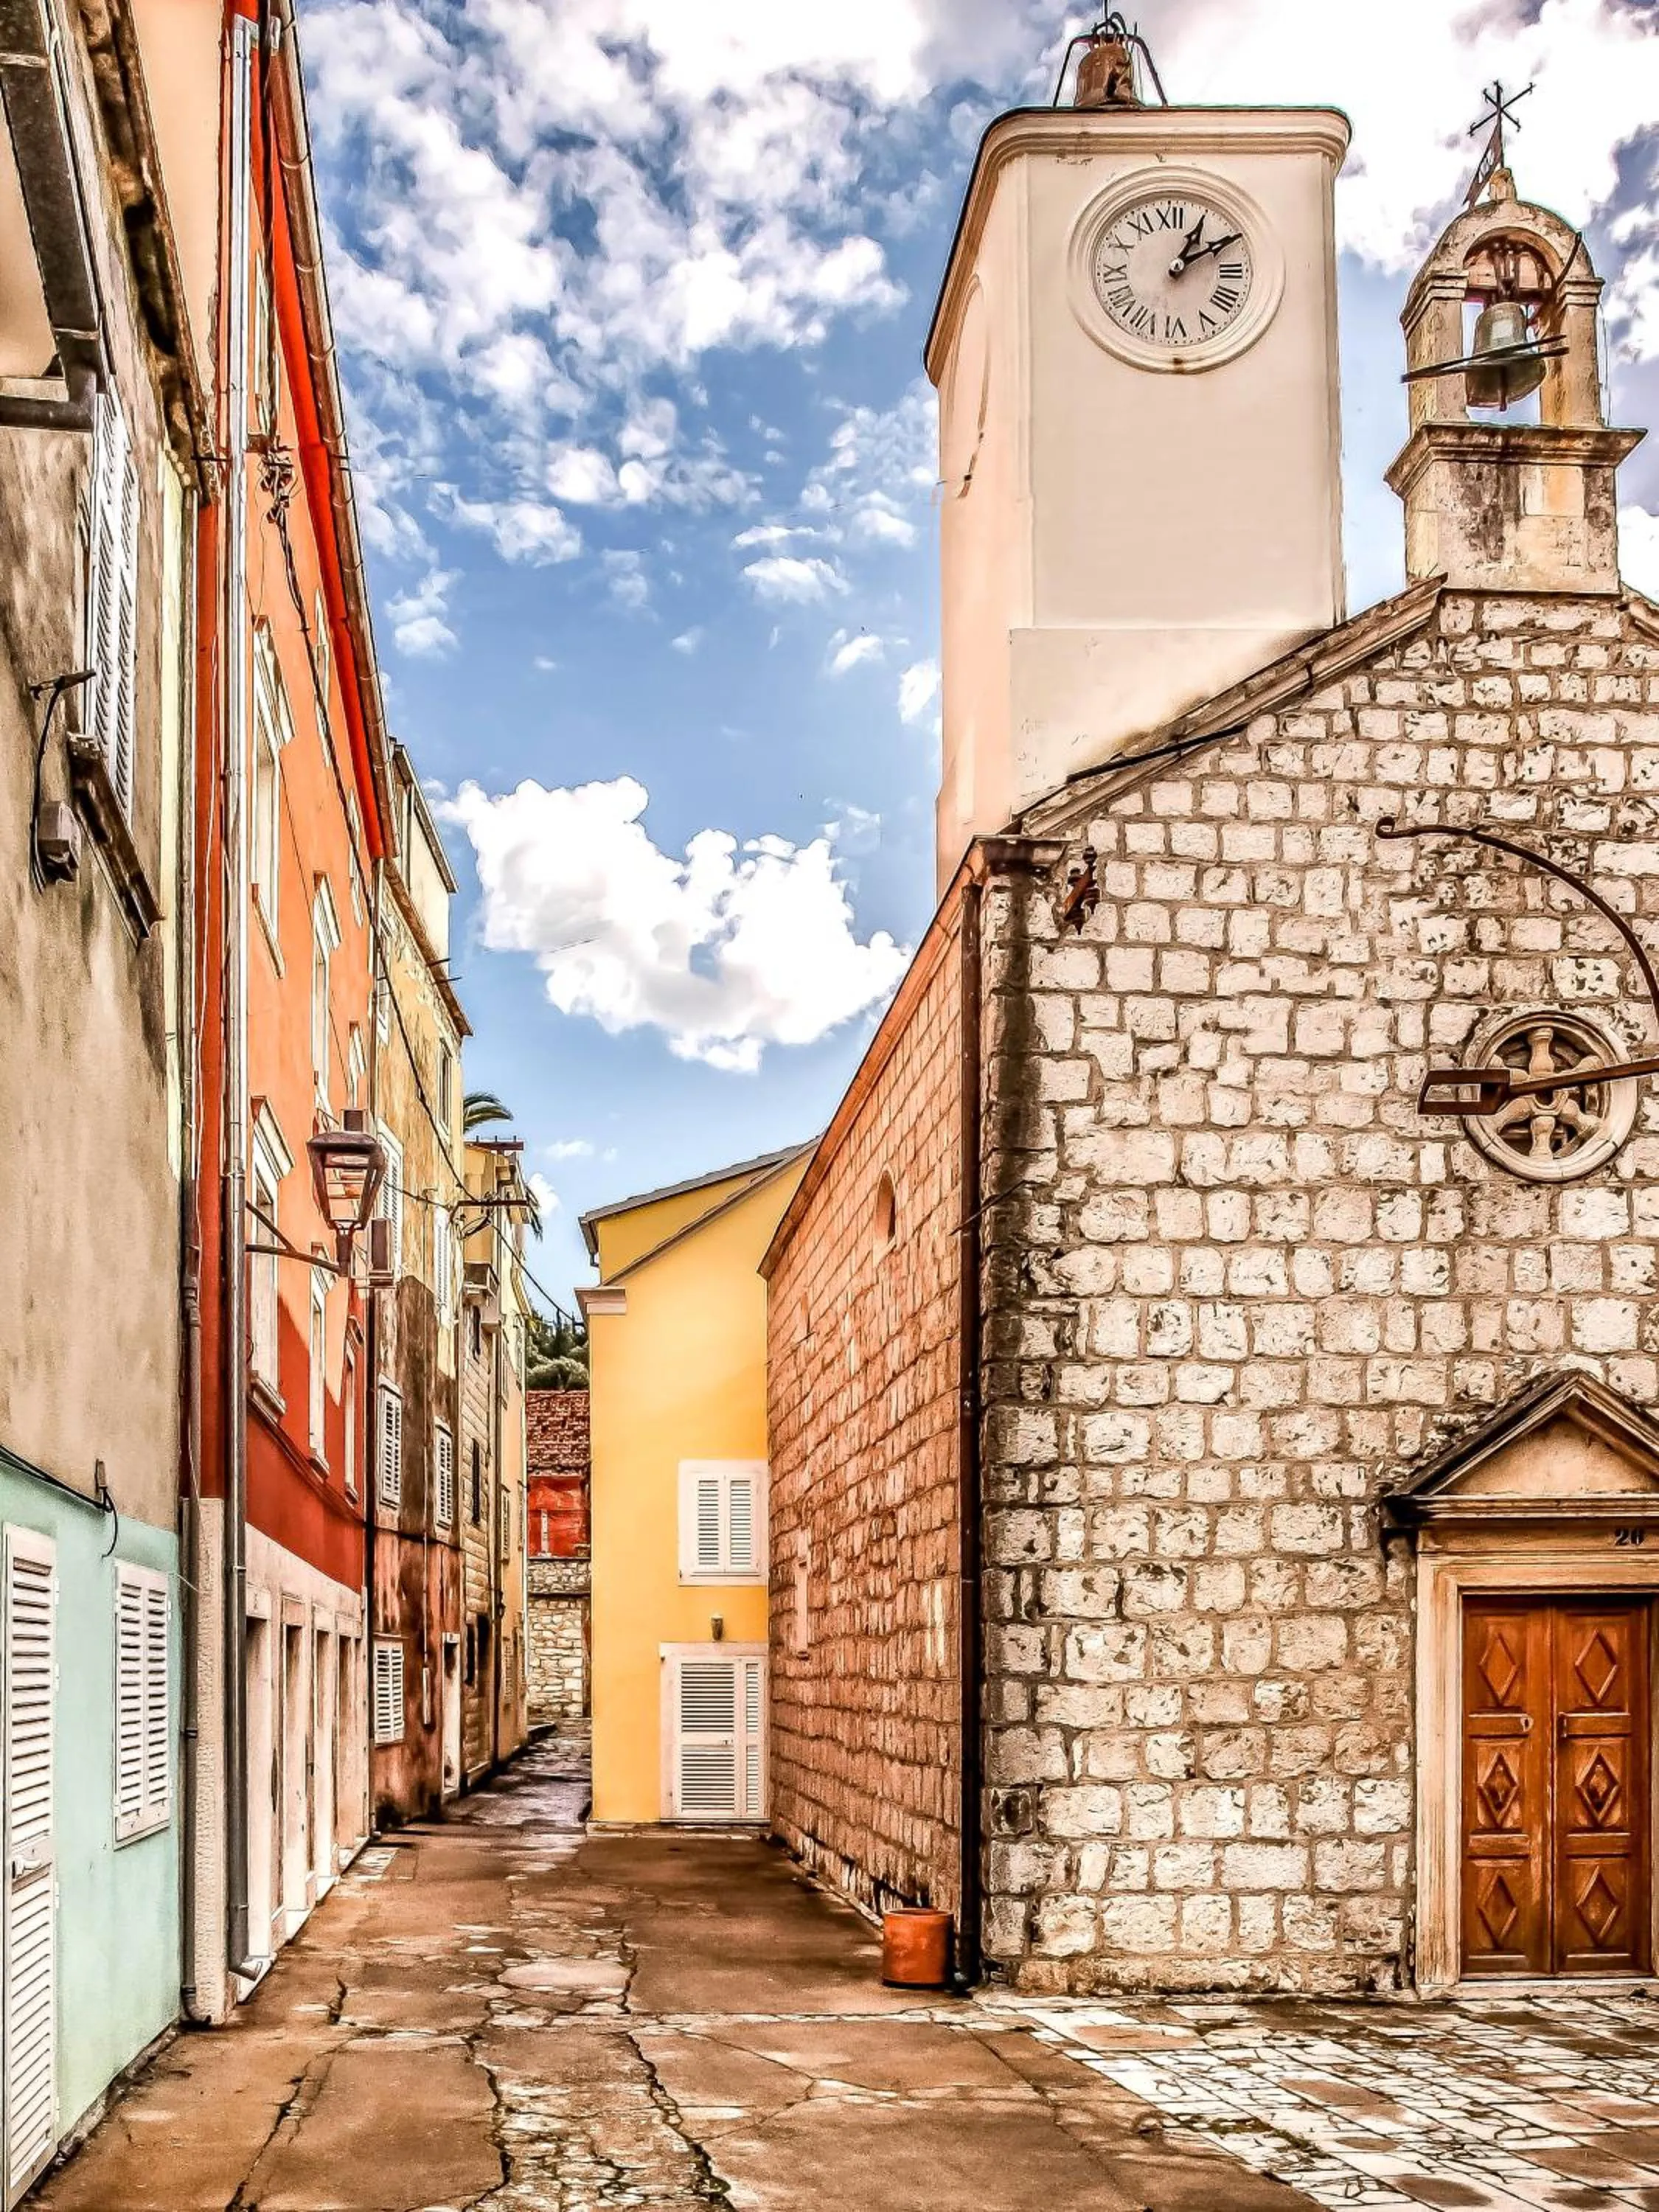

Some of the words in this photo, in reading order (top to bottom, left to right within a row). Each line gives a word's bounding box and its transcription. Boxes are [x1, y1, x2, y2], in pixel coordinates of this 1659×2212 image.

[1126, 212, 1155, 241] XI
[1155, 206, 1183, 230] XII
[1110, 234, 1135, 258] X
[1103, 264, 1127, 283] IX
[1219, 263, 1242, 279] III
[1210, 285, 1239, 313] IIII
[1130, 305, 1155, 335] VII
[1166, 316, 1186, 338] VI
[1198, 310, 1218, 332] V
